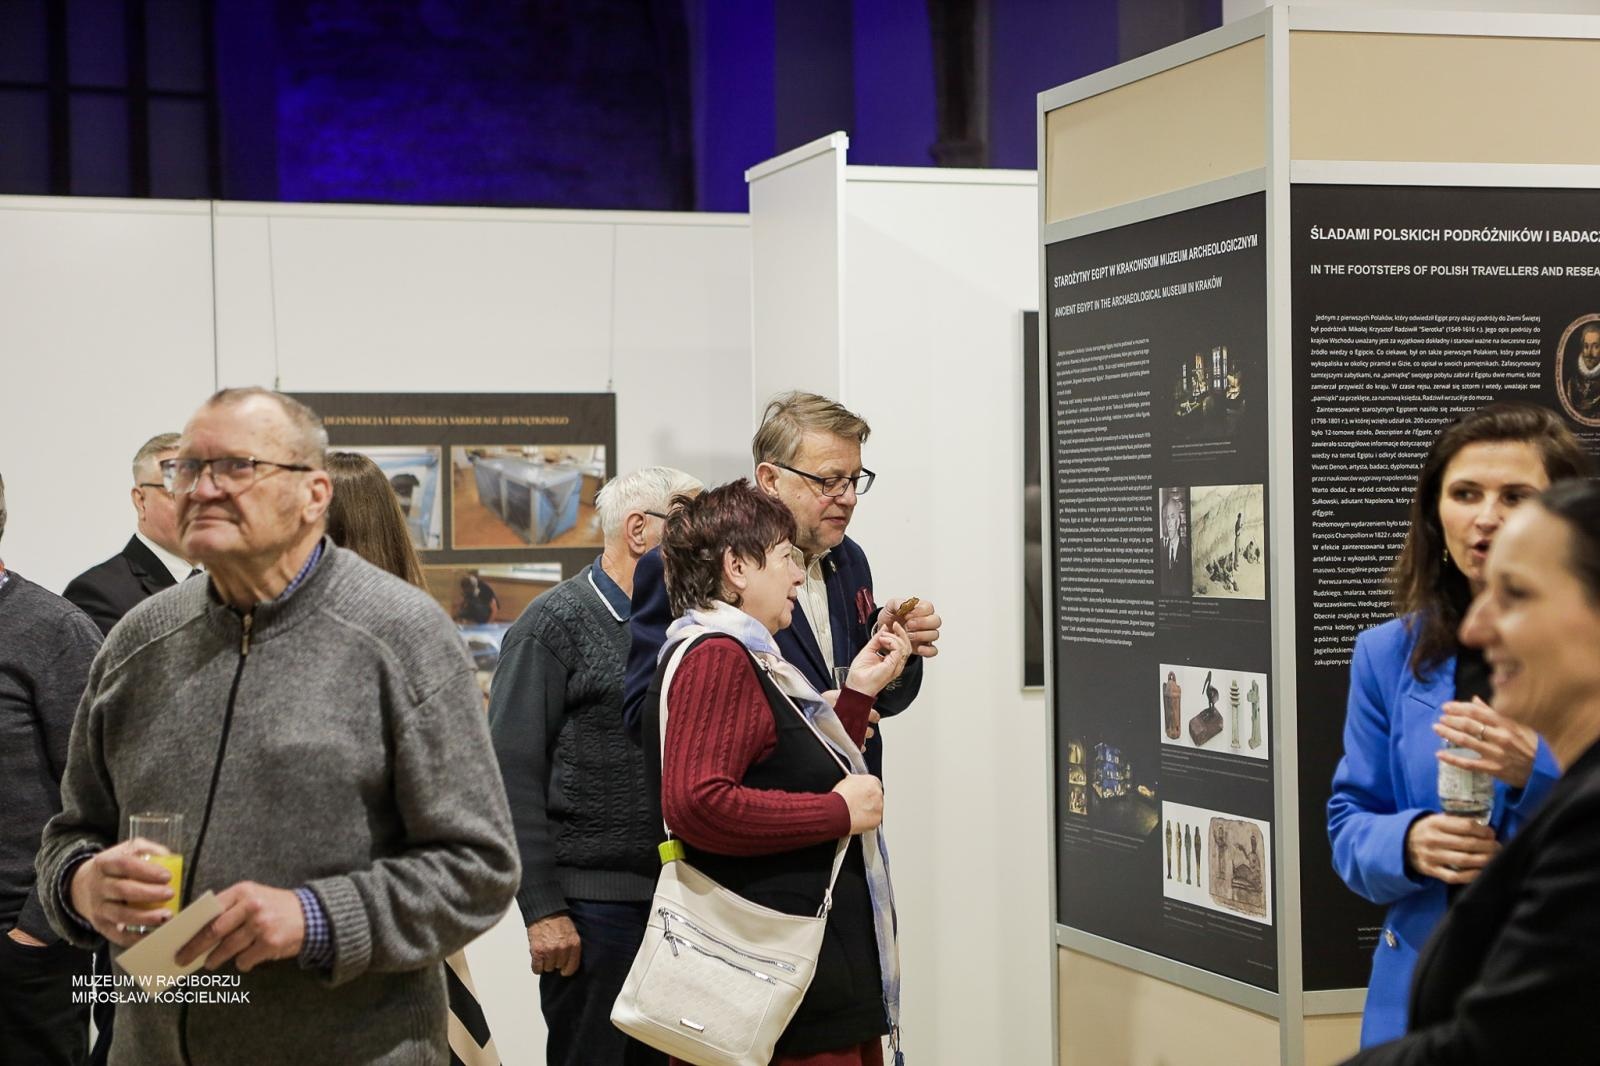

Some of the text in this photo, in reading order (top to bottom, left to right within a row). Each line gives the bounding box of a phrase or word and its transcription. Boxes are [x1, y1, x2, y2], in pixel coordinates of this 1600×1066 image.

[1310, 225, 1600, 243] ŚLADAMI POLSKICH PODRÓŻNIKÓW I BADAC
[1054, 234, 1258, 288] STAROŻYTNY EGIPT W KRAKOWSKIM MUZEUM ARCHEOLOGICZNYM
[1310, 264, 1321, 275] IN
[1324, 264, 1345, 275] THE
[1348, 265, 1411, 275] FOOTSTEPS
[1413, 265, 1428, 275] OF
[1430, 265, 1469, 276] POLISH
[1472, 266, 1539, 276] TRAVELLERS
[1541, 266, 1564, 276] AND
[1055, 275, 1223, 318] ANCIENT EGYPT IN THE ARCHAEOLOGICAL MUSEUM IN KRAKÓW
